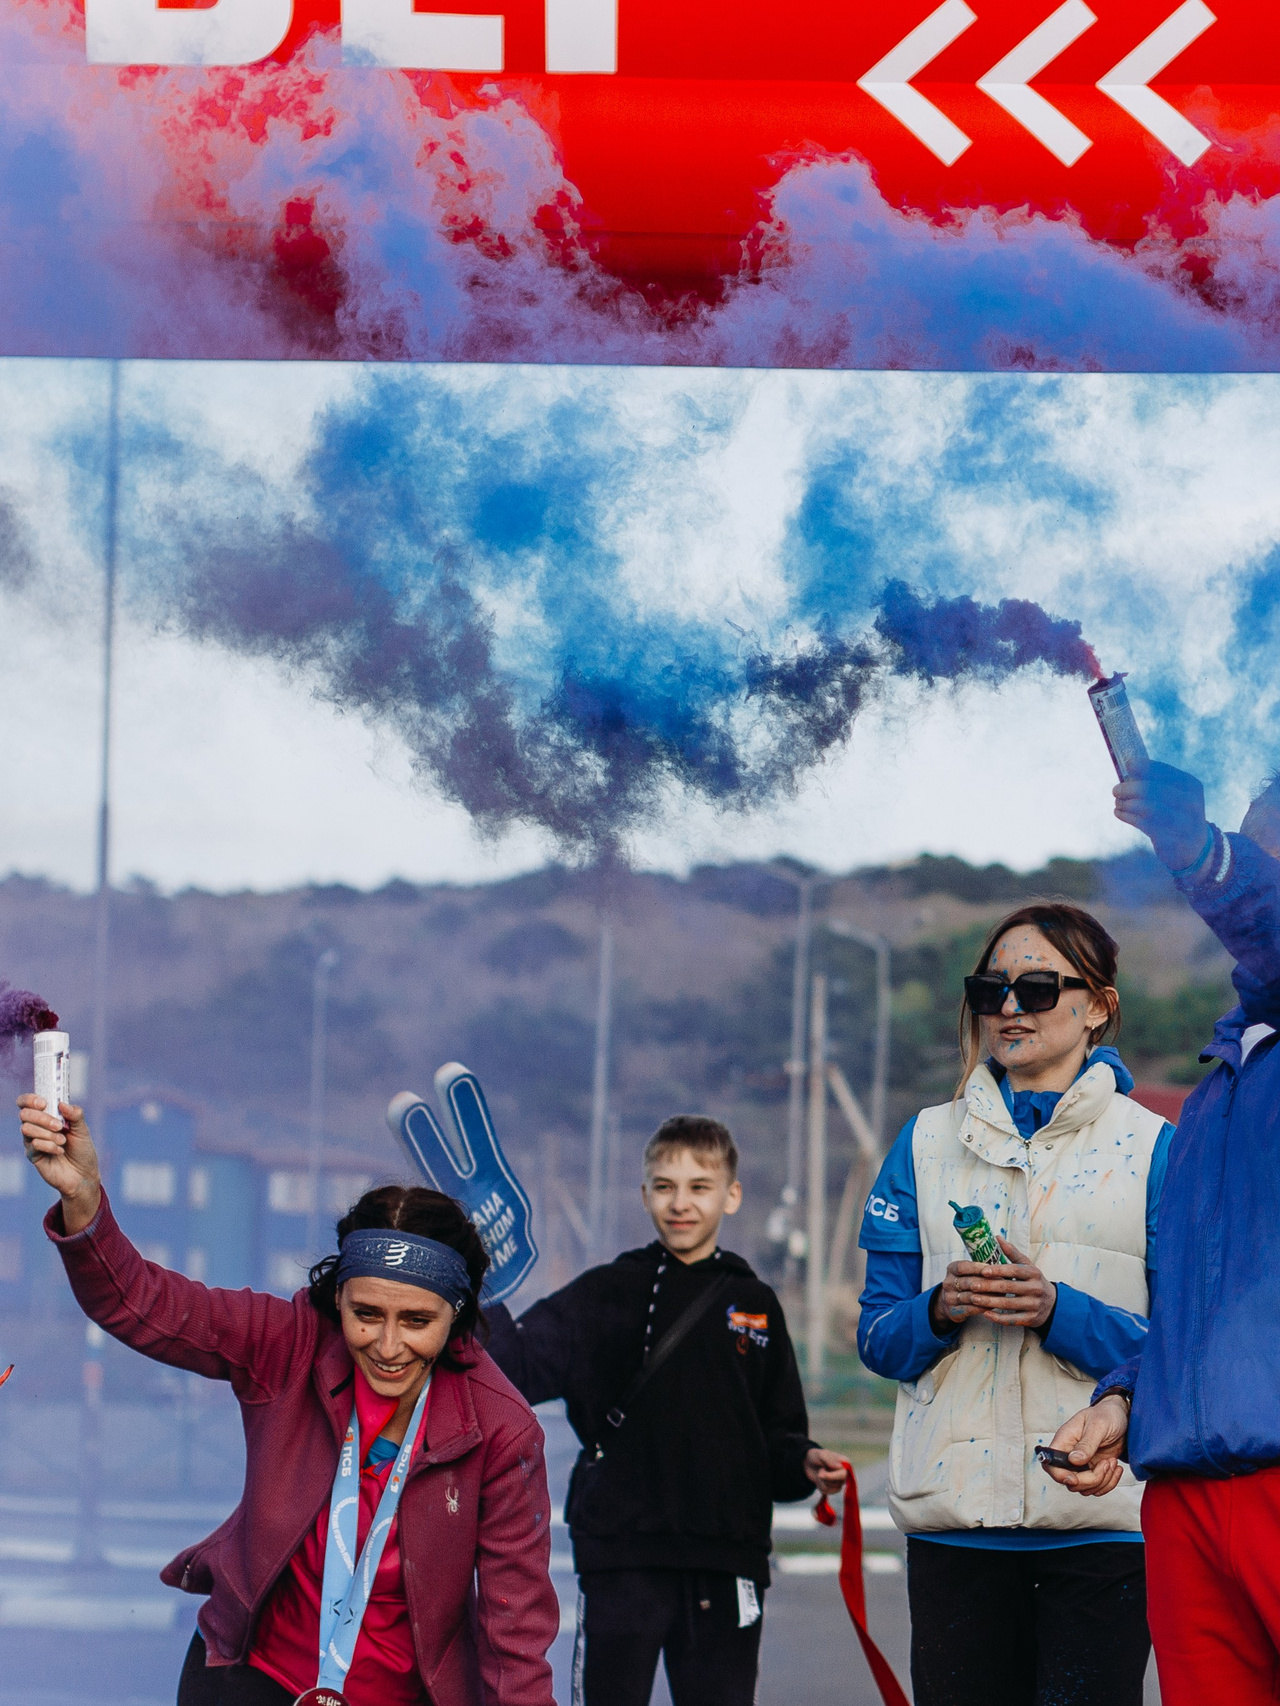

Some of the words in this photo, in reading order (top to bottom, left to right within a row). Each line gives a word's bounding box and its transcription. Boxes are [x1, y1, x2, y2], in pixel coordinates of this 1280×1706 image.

[470, 1191, 506, 1230] АНА
[482, 1206, 516, 1248] НОМ
[341, 1445, 354, 1477] ПСБ
[396, 1443, 412, 1473] ПСБ
